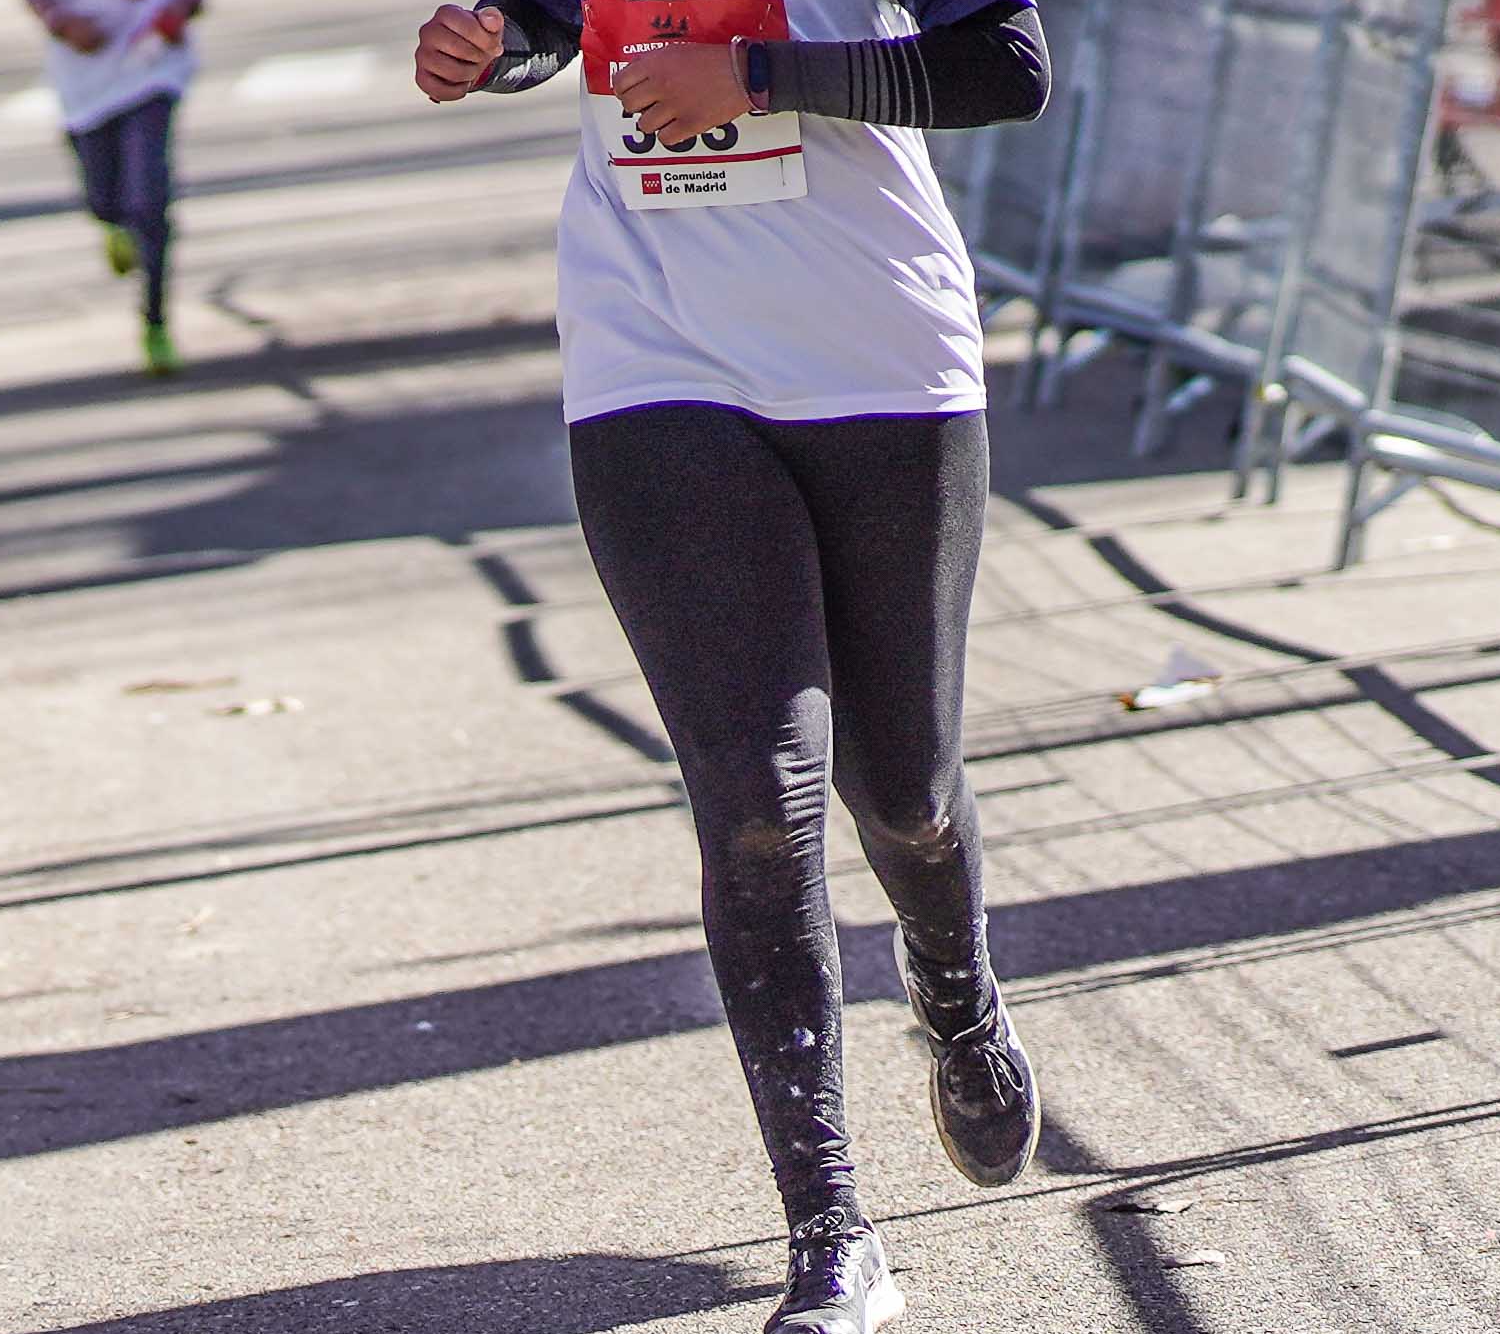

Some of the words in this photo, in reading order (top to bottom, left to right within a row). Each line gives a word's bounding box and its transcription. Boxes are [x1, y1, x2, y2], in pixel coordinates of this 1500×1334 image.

[623, 41, 669, 54] CARRE
[664, 171, 726, 181] Comunidad
[665, 184, 680, 194] de
[684, 182, 727, 193] Madrid
